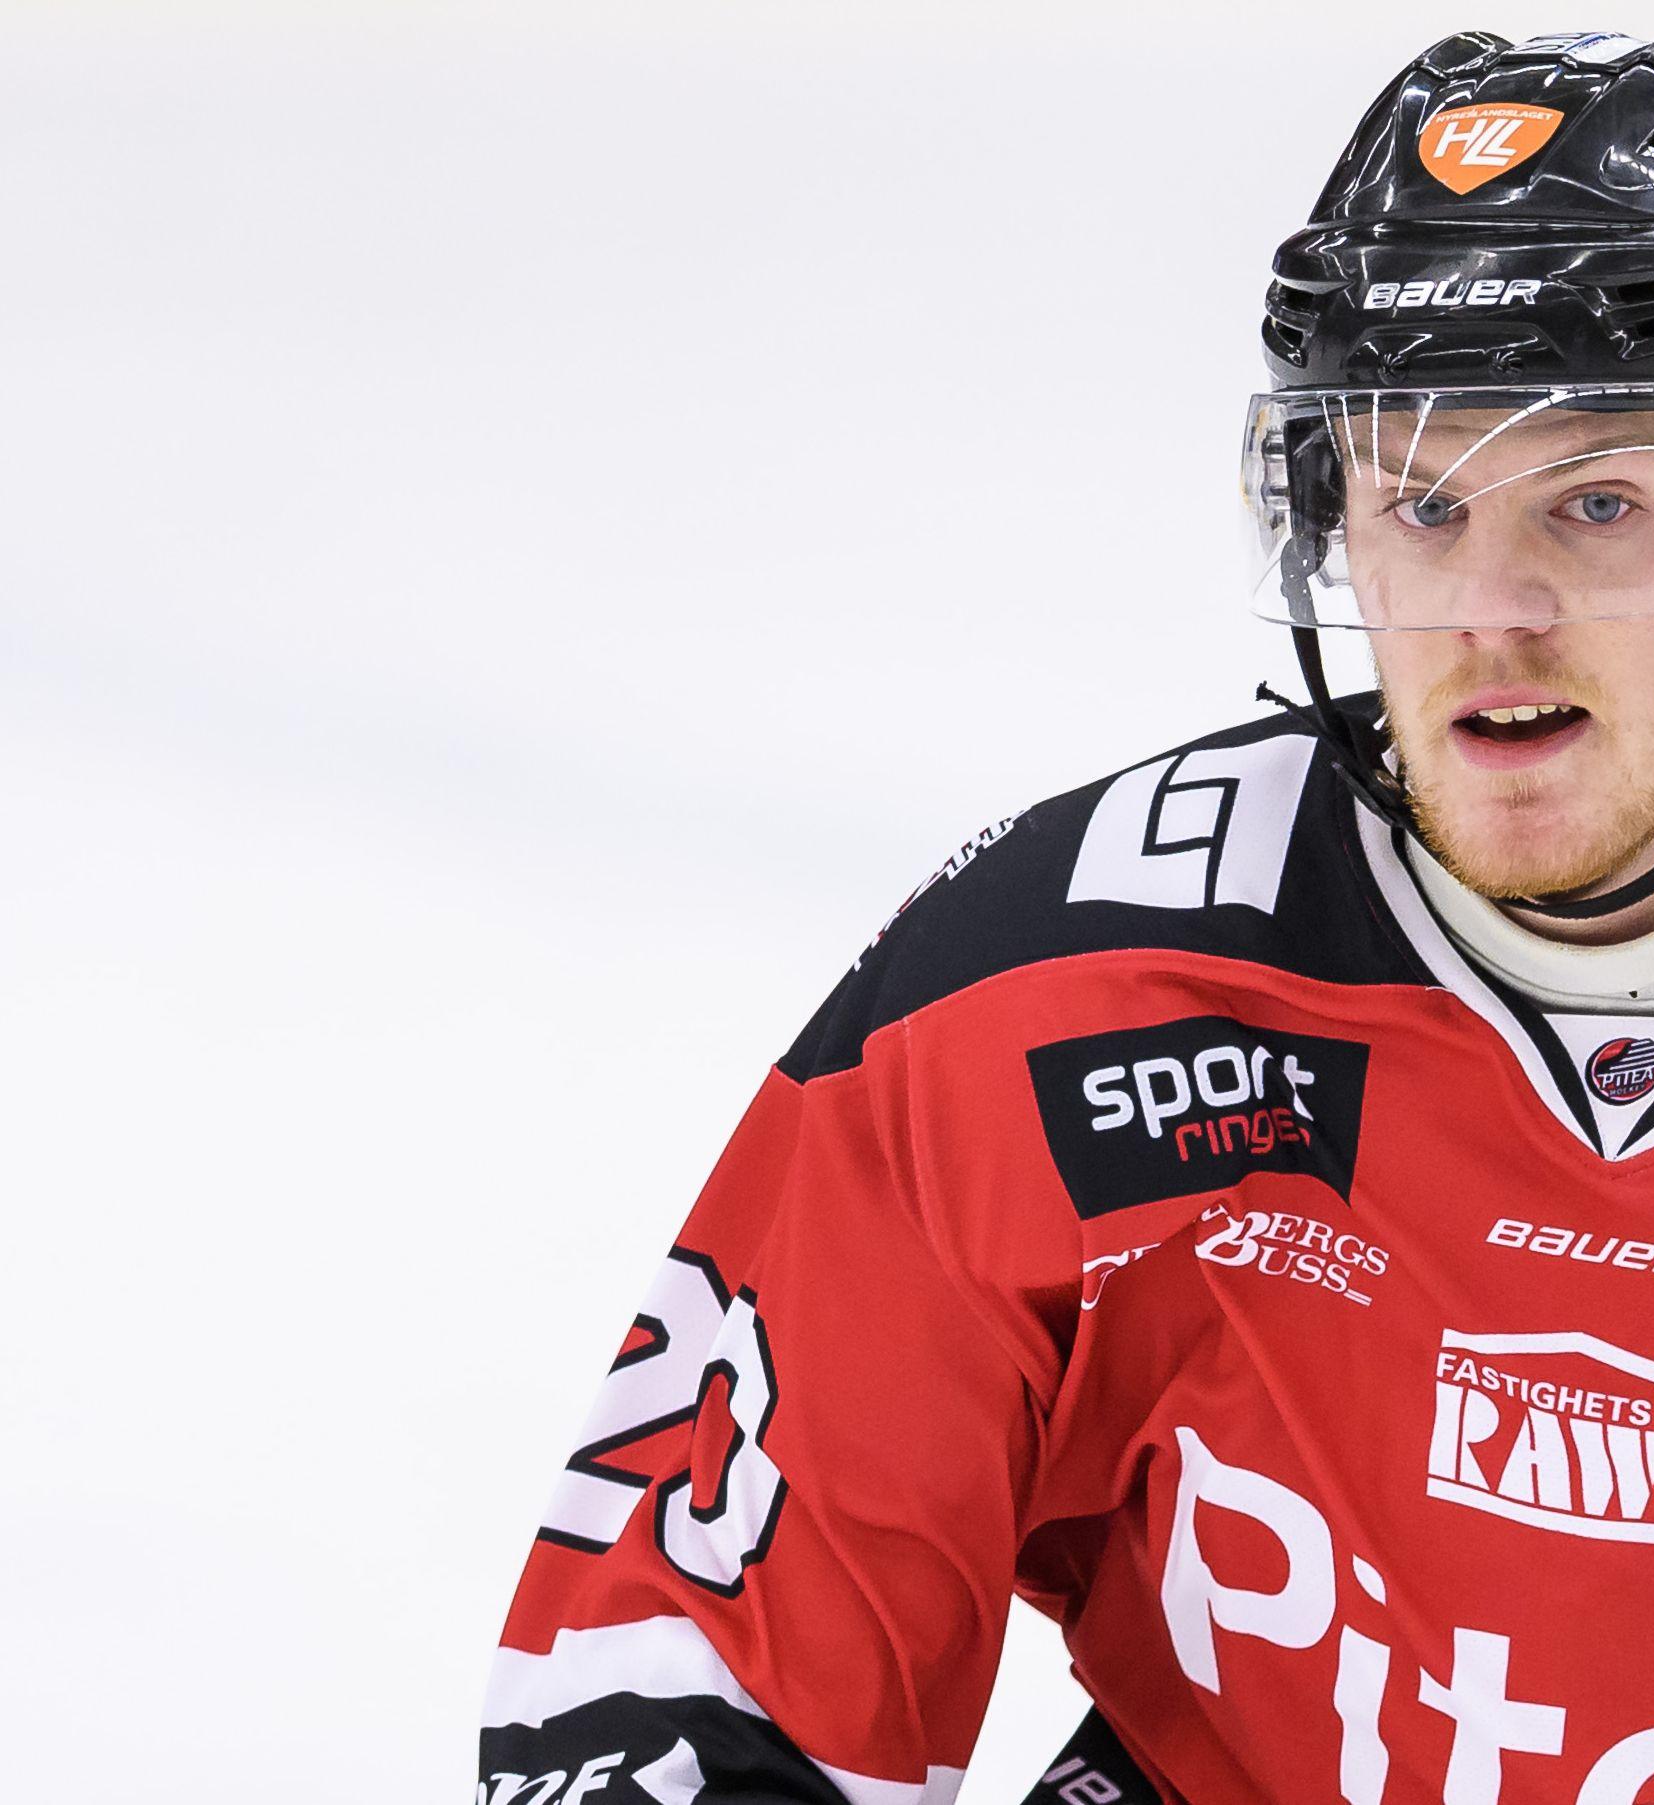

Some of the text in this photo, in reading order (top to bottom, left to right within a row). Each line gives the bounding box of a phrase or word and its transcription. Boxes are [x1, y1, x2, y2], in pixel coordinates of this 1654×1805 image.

[1432, 118, 1525, 167] HLL
[1082, 1045, 1316, 1139] sport
[1435, 1351, 1652, 1427] FASTIGHETS
